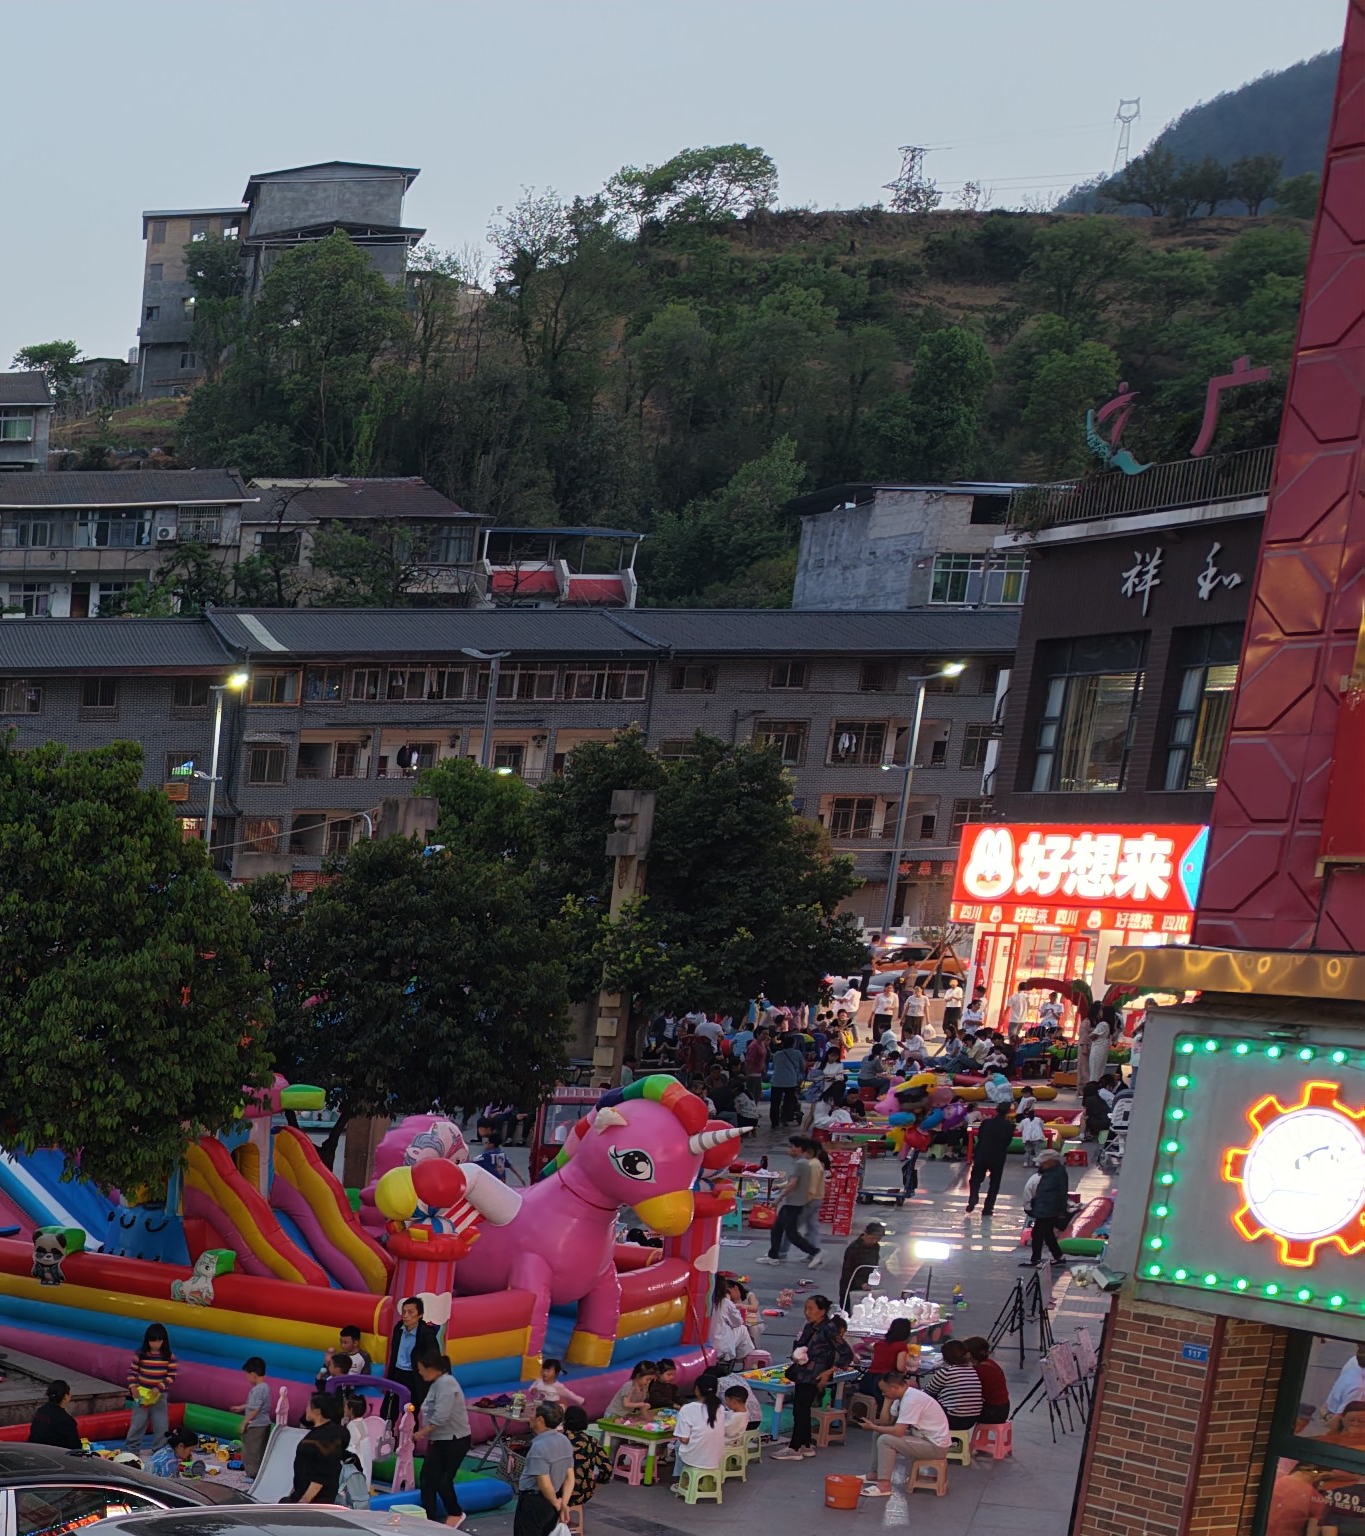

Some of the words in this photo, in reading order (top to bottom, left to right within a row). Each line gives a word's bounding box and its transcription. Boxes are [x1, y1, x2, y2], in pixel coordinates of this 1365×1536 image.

[1121, 542, 1242, 617] 祥和
[1019, 830, 1174, 900] 好想来
[959, 905, 983, 920] 四川
[1013, 906, 1050, 924] 好想来
[1054, 909, 1080, 926] 四川
[1115, 912, 1154, 930] 好想来
[1161, 915, 1188, 932] 四川
